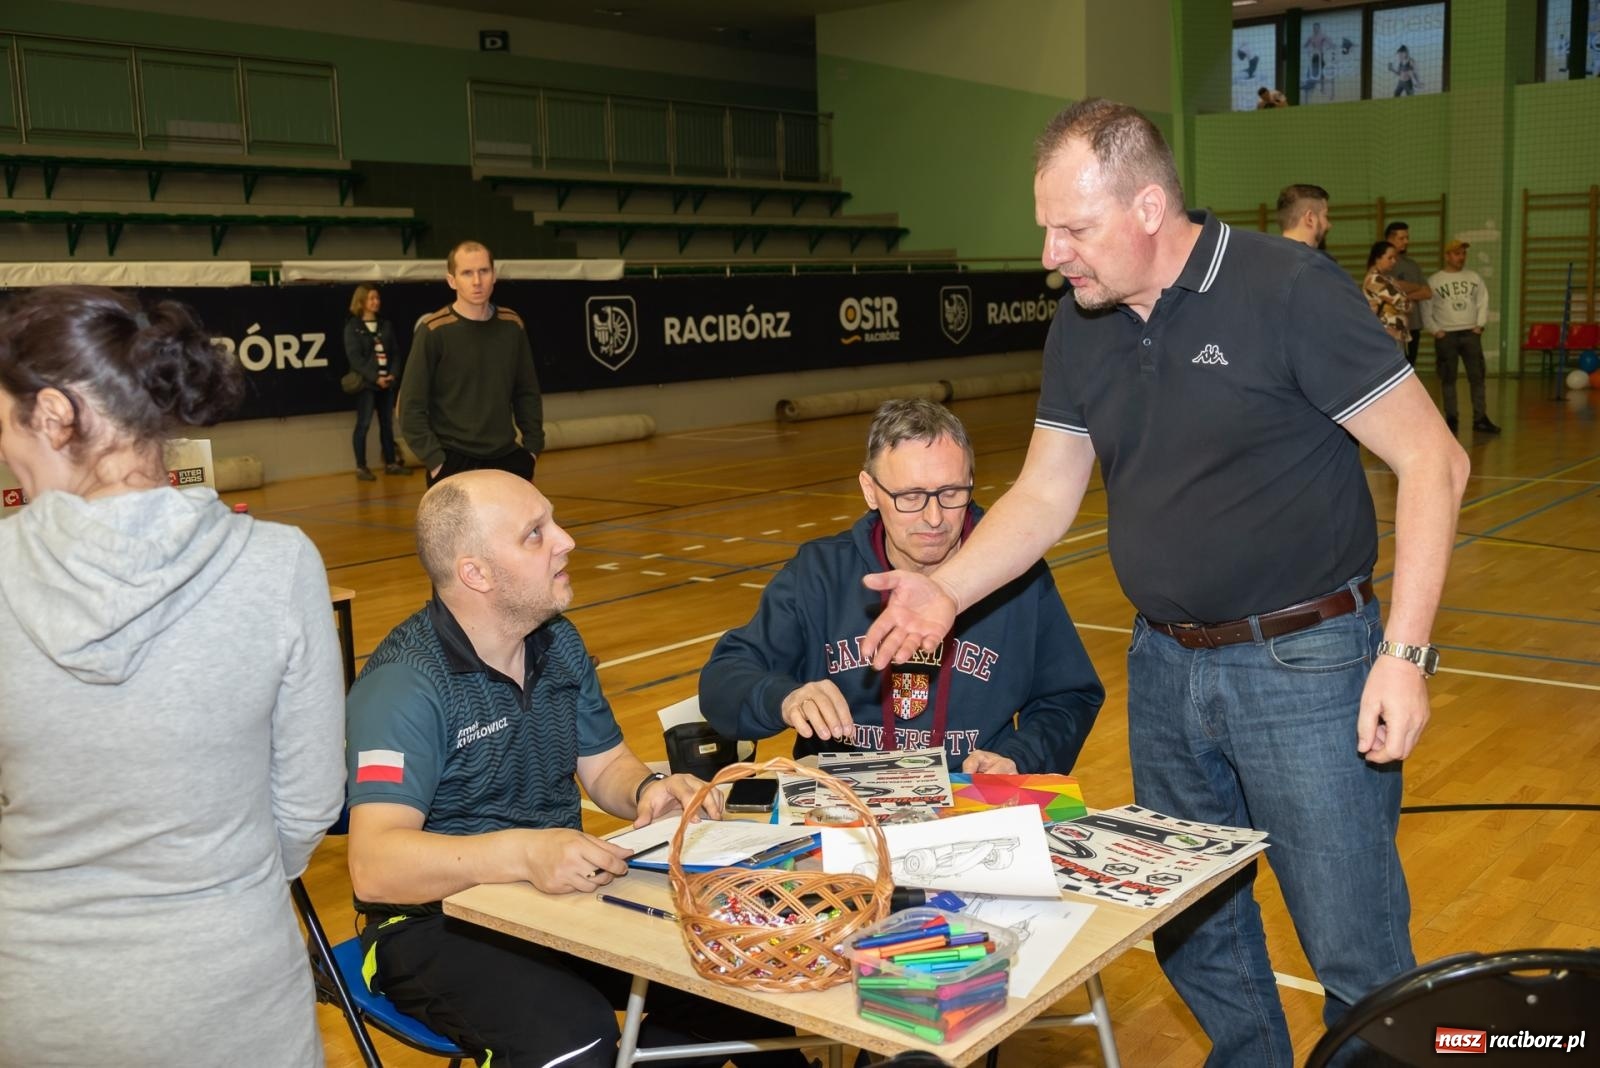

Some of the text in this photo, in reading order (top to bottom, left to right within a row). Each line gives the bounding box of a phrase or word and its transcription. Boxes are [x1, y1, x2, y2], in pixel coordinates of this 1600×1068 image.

[1435, 280, 1479, 299] WEST
[986, 293, 1058, 325] RACIBÓR
[663, 303, 792, 345] RACIBÓRZ
[864, 330, 901, 343] RACIBÓRZ
[178, 468, 202, 479] INTER
[180, 476, 203, 485] CARS
[825, 636, 1000, 682] CARIDGE
[834, 723, 980, 756] NIVERSTY
